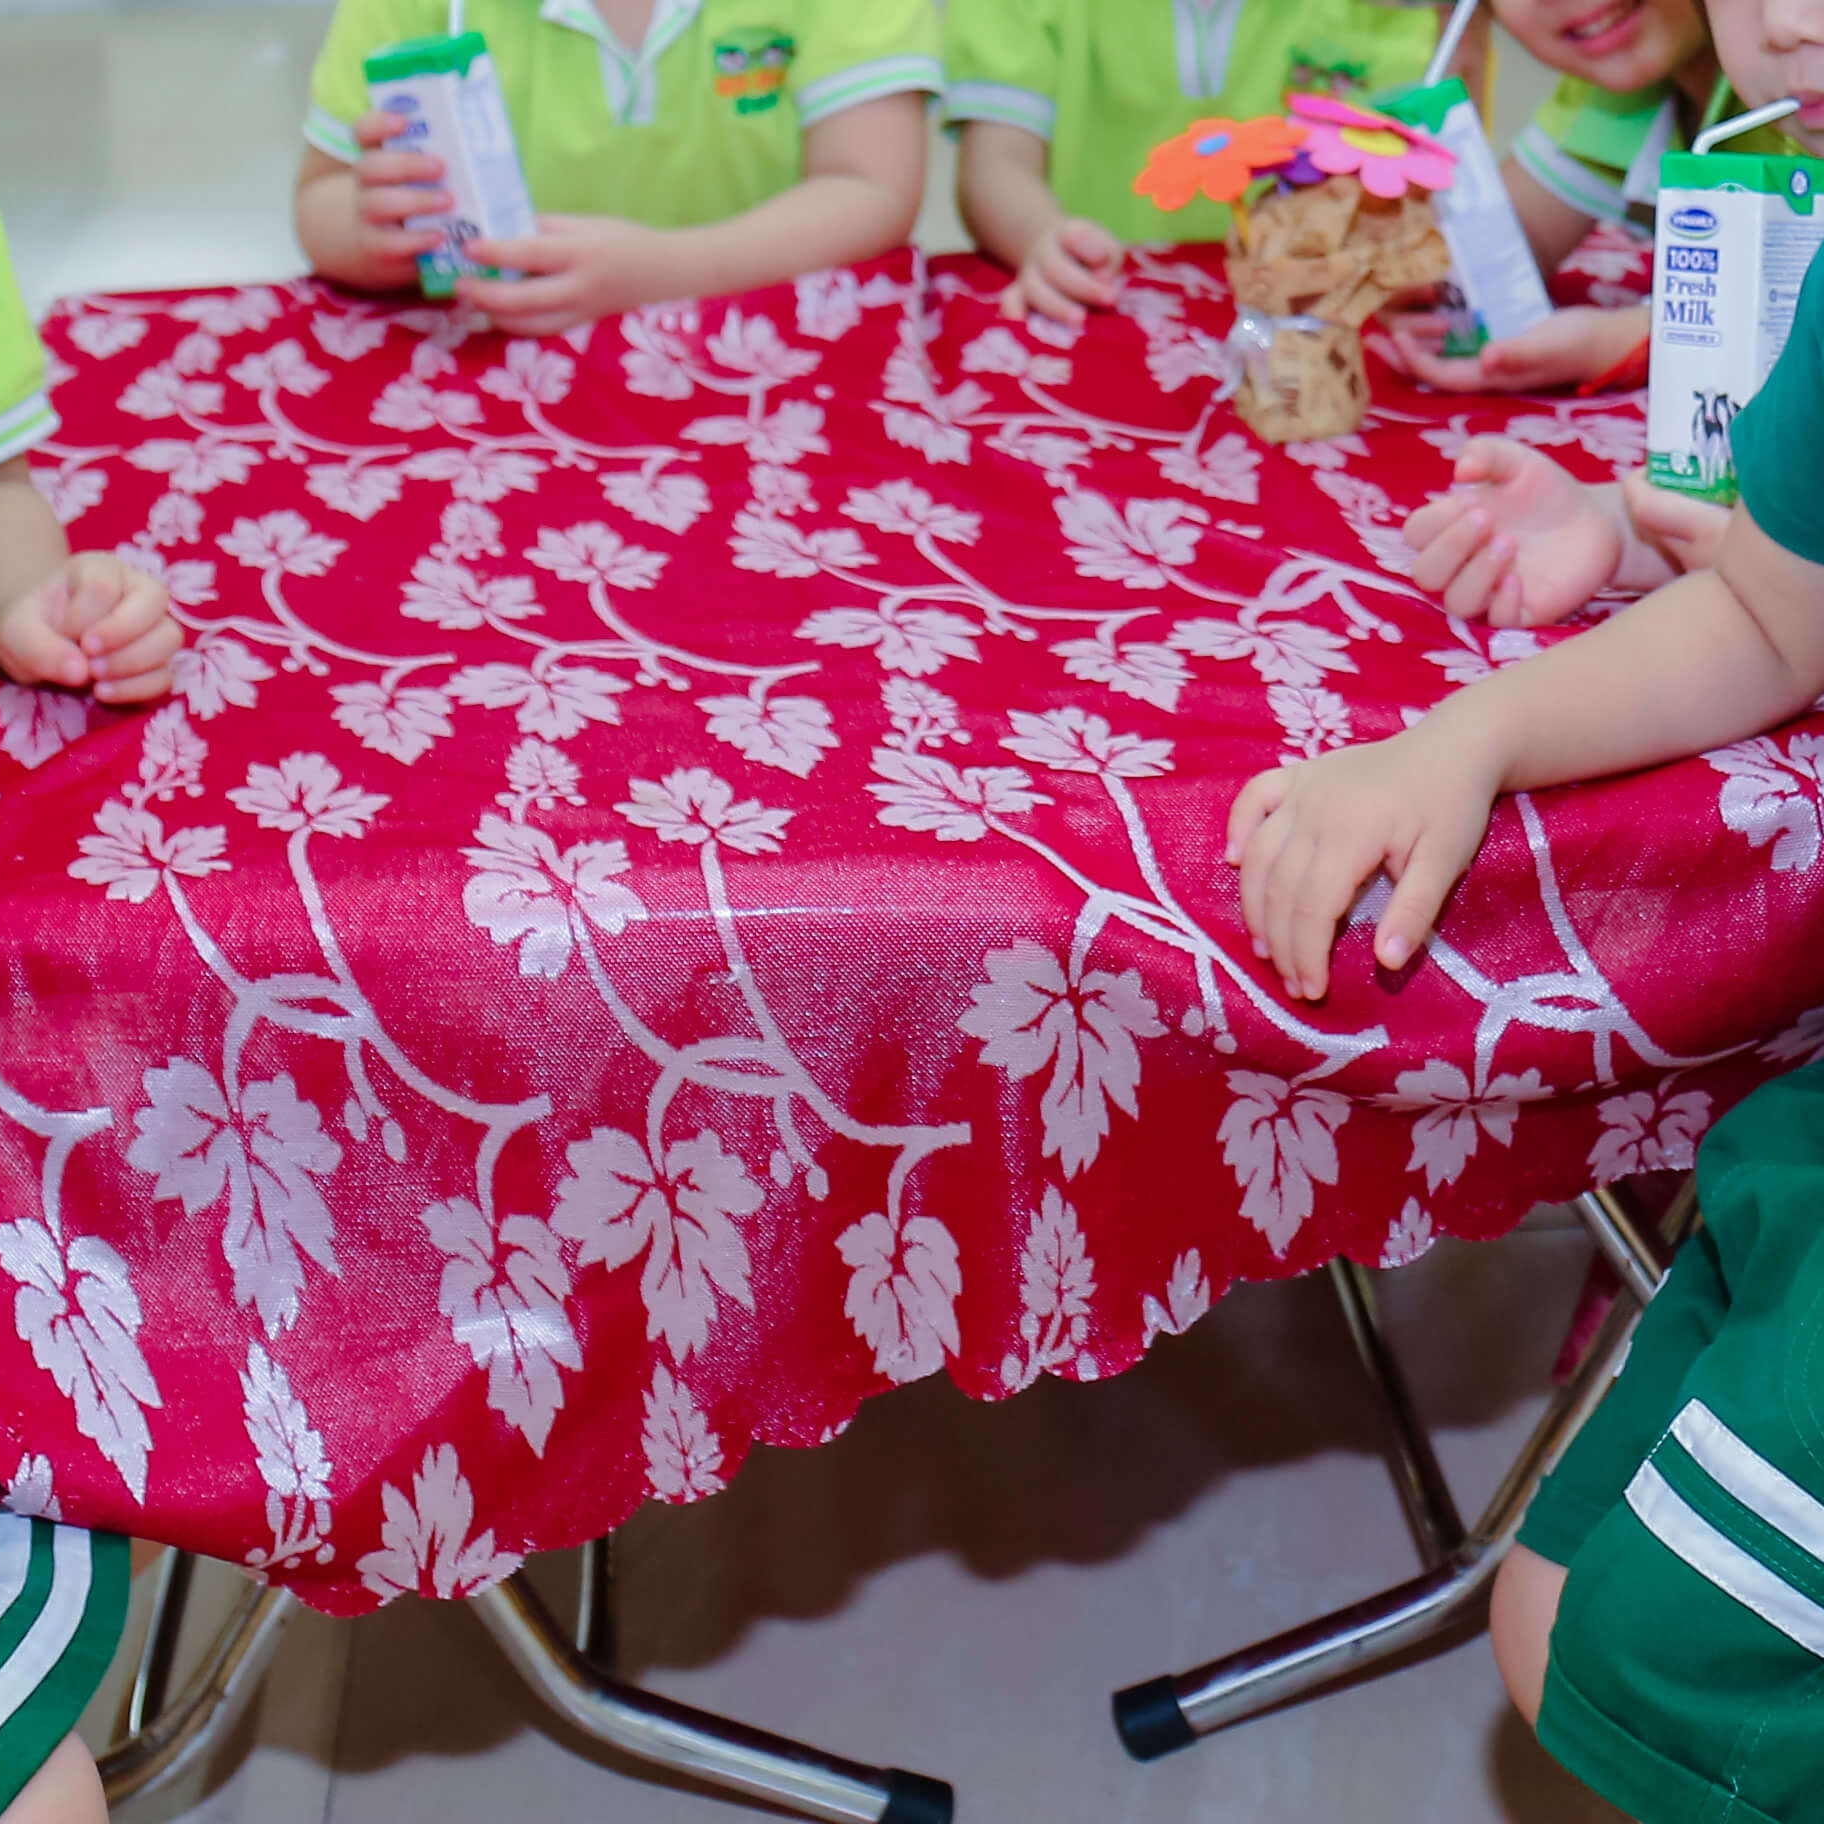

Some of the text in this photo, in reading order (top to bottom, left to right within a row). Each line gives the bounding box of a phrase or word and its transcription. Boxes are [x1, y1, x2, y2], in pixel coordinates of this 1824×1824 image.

[1670, 249, 1716, 270] 100%
[1665, 276, 1717, 297] Fresh
[1664, 301, 1715, 326] Milk
